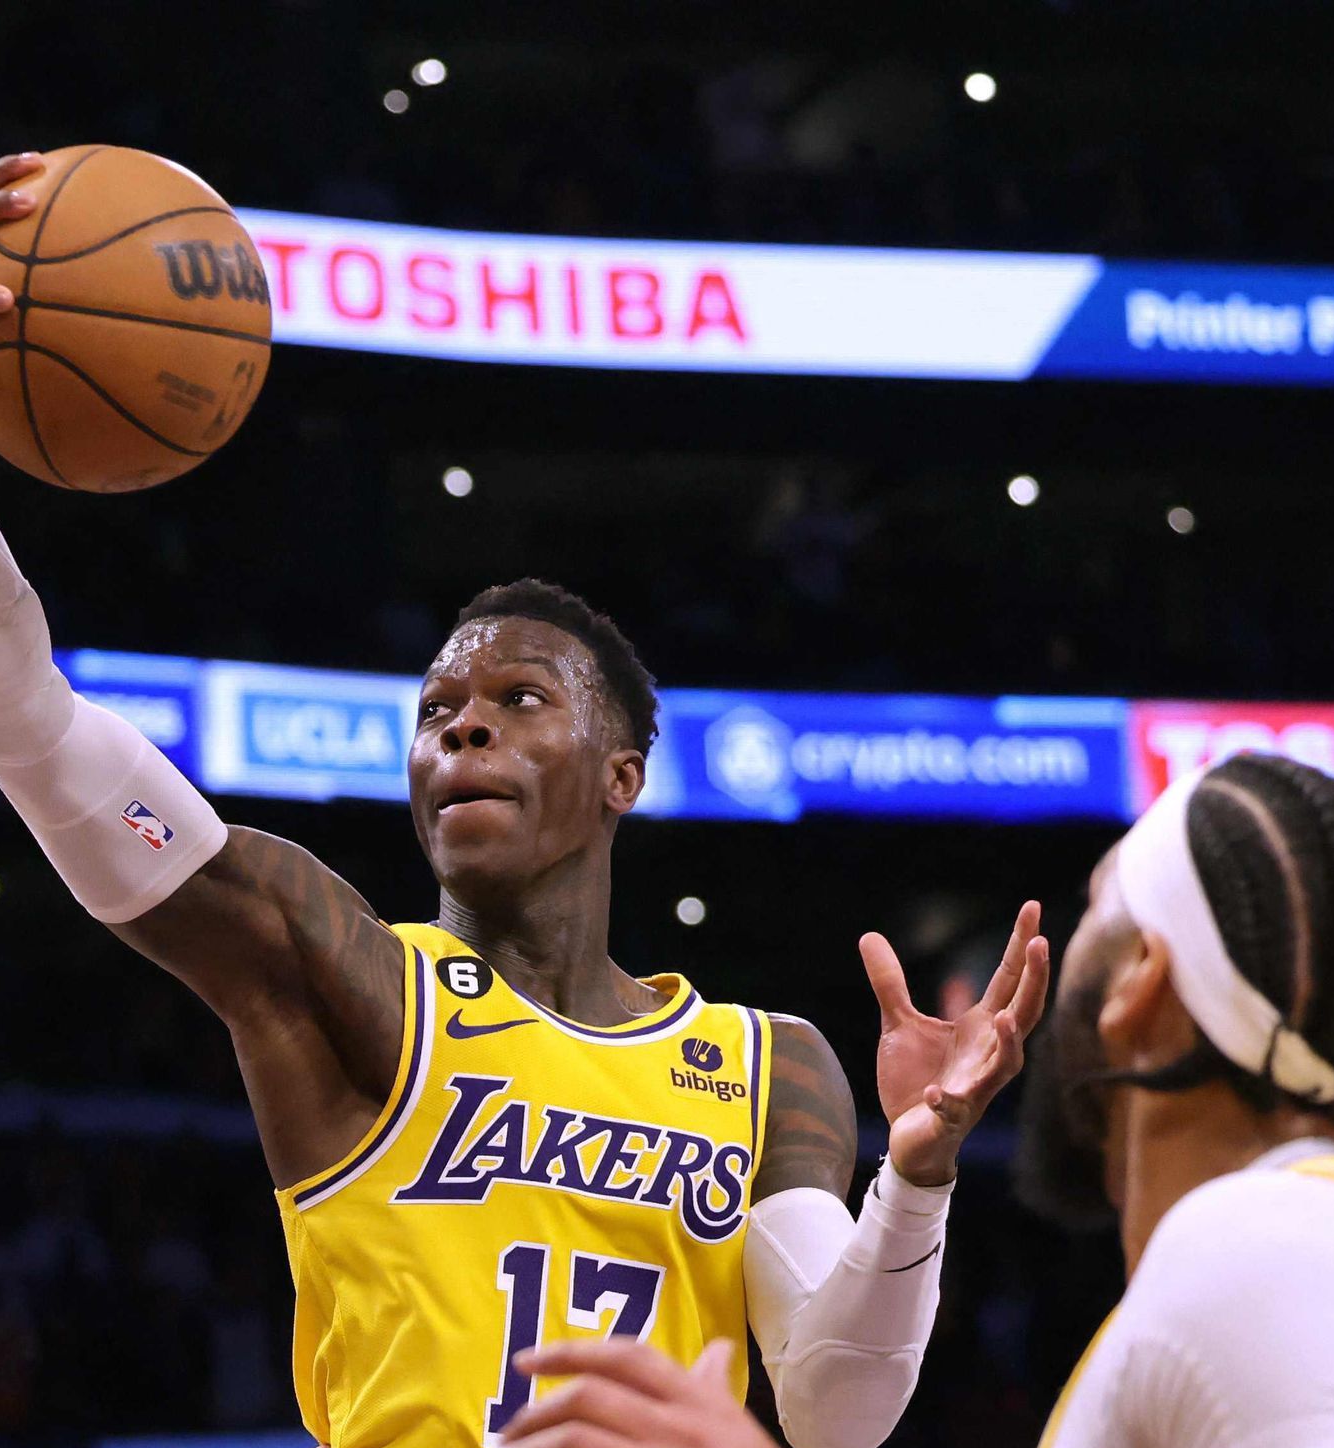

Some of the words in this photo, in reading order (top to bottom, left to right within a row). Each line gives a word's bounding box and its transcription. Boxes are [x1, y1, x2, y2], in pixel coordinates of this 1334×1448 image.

[259, 239, 746, 342] TOSHIBA
[1125, 290, 1304, 356] Printer
[251, 703, 401, 766] UCLA
[791, 729, 1090, 791] crypto.com
[448, 962, 480, 994] 6
[670, 1067, 746, 1102] bibigo
[389, 1073, 754, 1245] LAKERS
